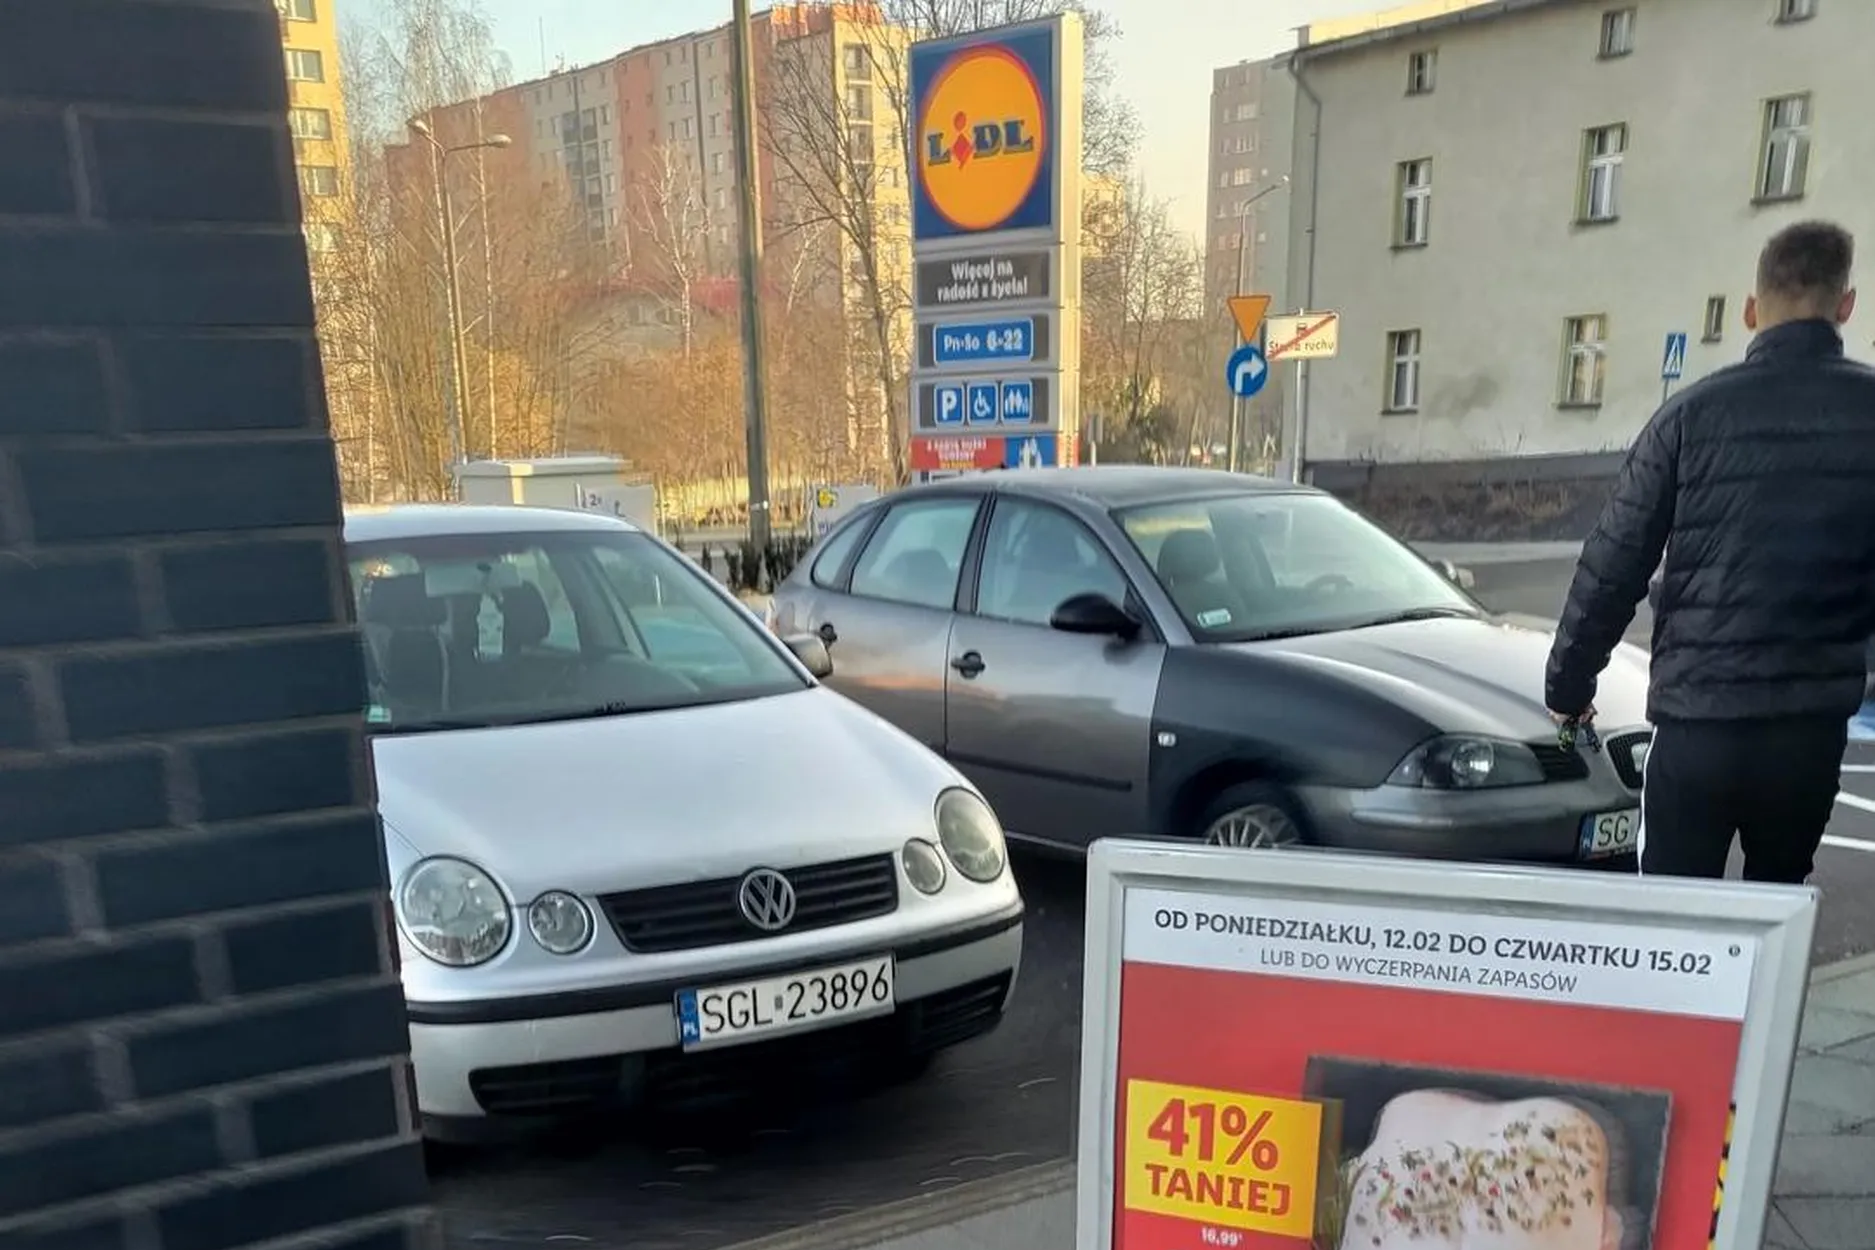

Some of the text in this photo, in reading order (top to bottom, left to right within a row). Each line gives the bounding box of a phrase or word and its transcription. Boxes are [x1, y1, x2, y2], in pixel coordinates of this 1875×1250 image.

[1305, 339, 1334, 351] ruchu
[942, 390, 957, 420] P
[1598, 815, 1629, 847] SG
[1154, 908, 1188, 931] OD
[1195, 912, 1377, 950] PONIEDZIAŁKU,
[1383, 929, 1441, 952] 12.02
[1449, 934, 1487, 956] DO
[1494, 938, 1640, 969] CZWARTKU
[1648, 950, 1712, 976] 15.02
[1260, 948, 1578, 994] LUB DO WYCZERPANIA ZAPASÓW
[683, 1022, 699, 1036] PL
[1147, 1097, 1279, 1171] 41%
[1145, 1163, 1292, 1216] TANIEJ
